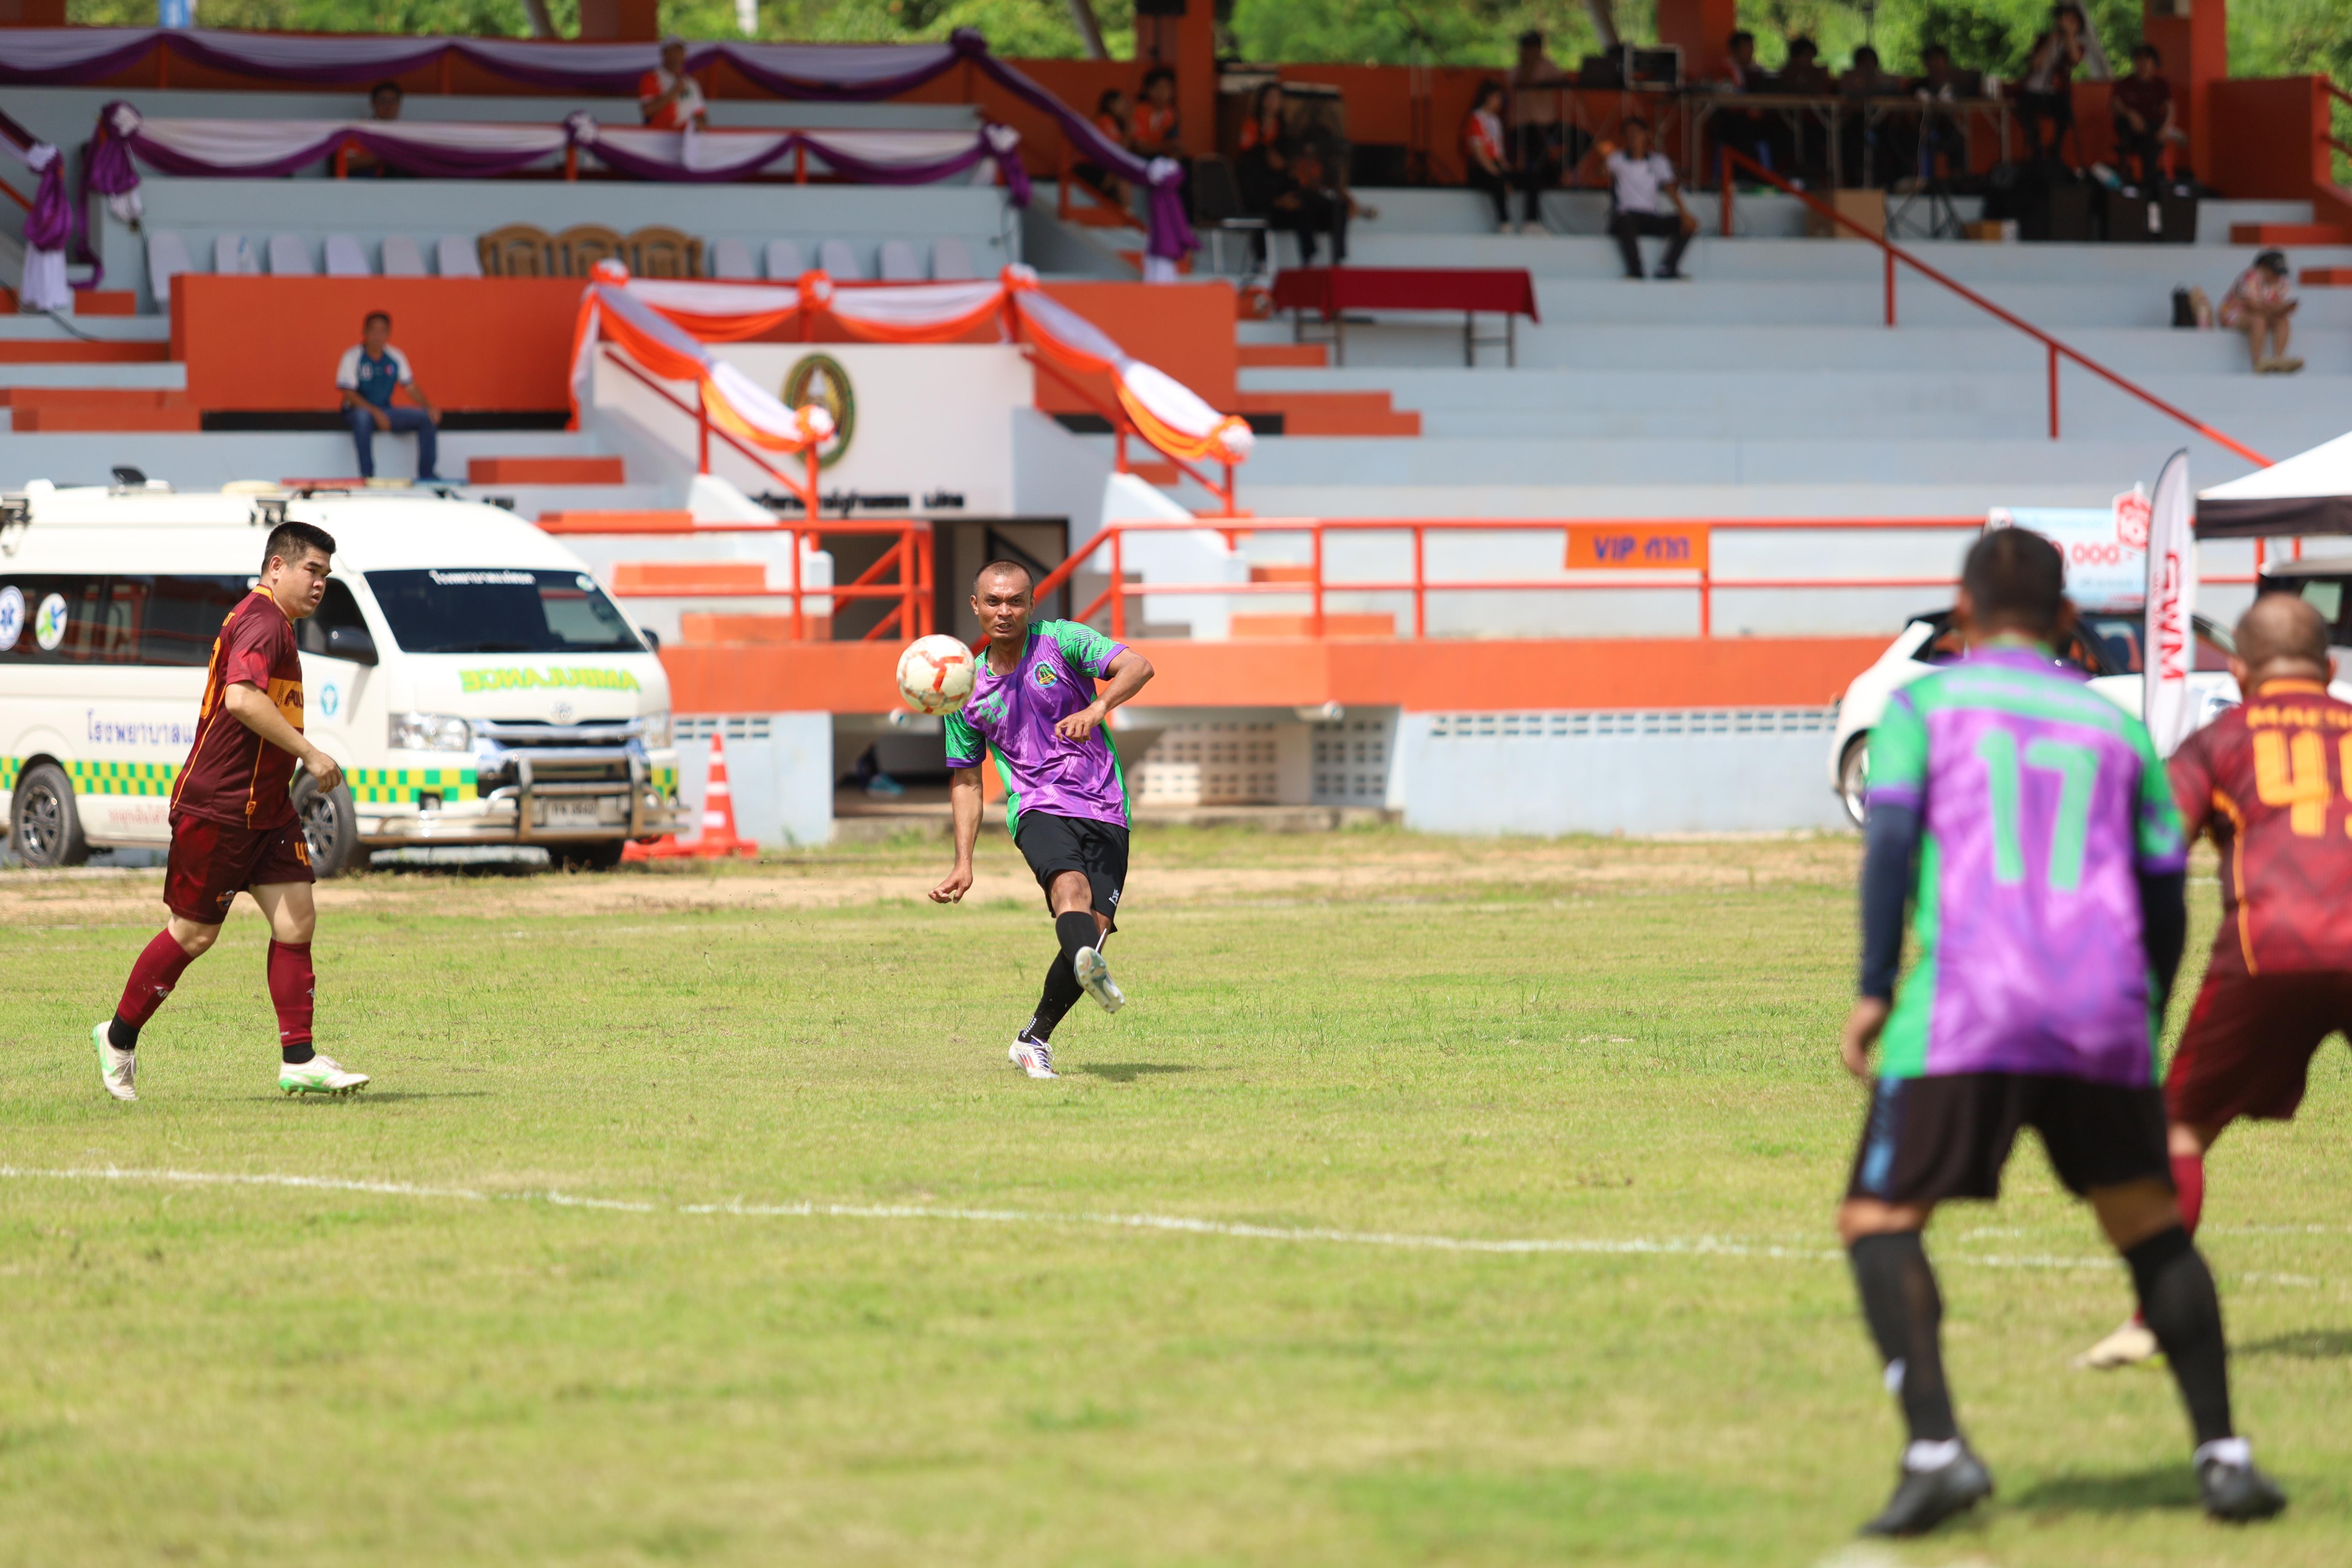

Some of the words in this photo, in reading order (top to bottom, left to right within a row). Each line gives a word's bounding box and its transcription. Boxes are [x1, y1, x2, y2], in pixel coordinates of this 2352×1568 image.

[1593, 535, 1636, 561] VIP
[975, 690, 1008, 724] 69
[1978, 729, 2098, 891] 17
